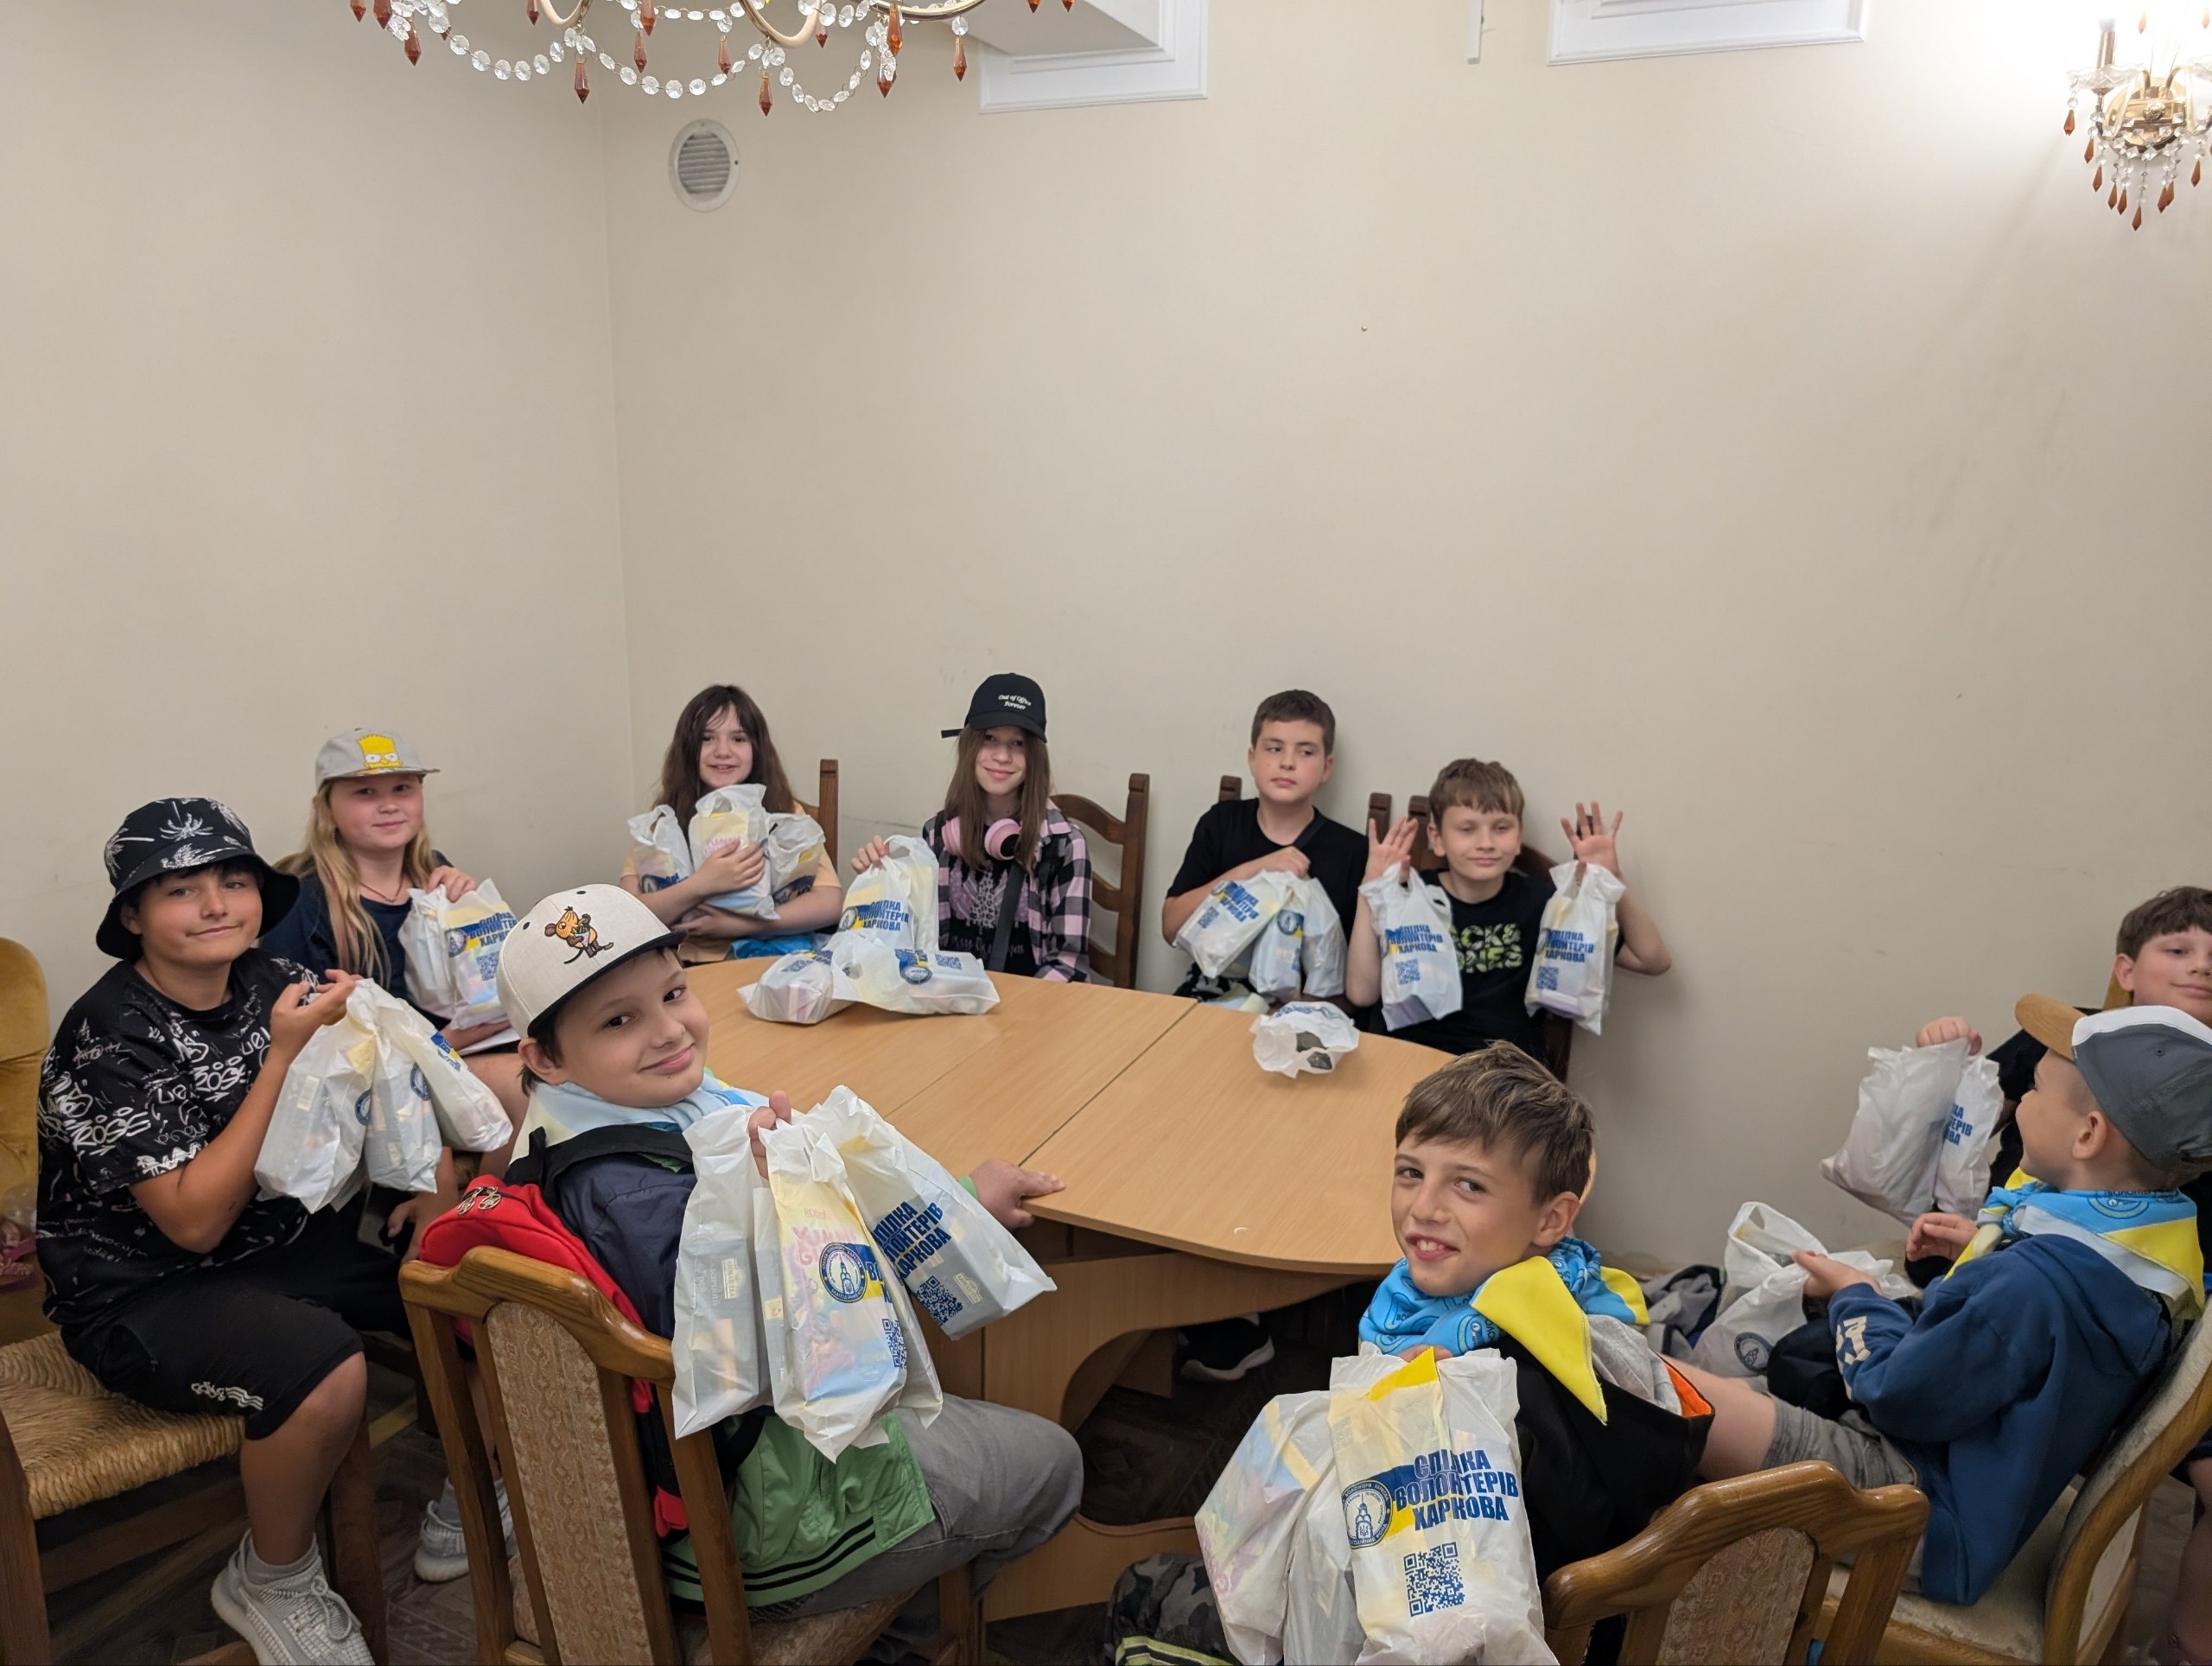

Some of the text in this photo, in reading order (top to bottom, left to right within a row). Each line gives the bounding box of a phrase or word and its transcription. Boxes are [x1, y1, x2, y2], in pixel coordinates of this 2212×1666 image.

[874, 1201, 918, 1247] ПІЛКА
[883, 1202, 944, 1264] ЛОНТЕРІВ
[898, 1226, 952, 1279] АРКОВА
[1414, 1449, 1491, 1478] СПІЛКА
[1395, 1471, 1519, 1511] ВОЛОНТЕРІВ
[1412, 1495, 1510, 1531] ХАРКОВА
